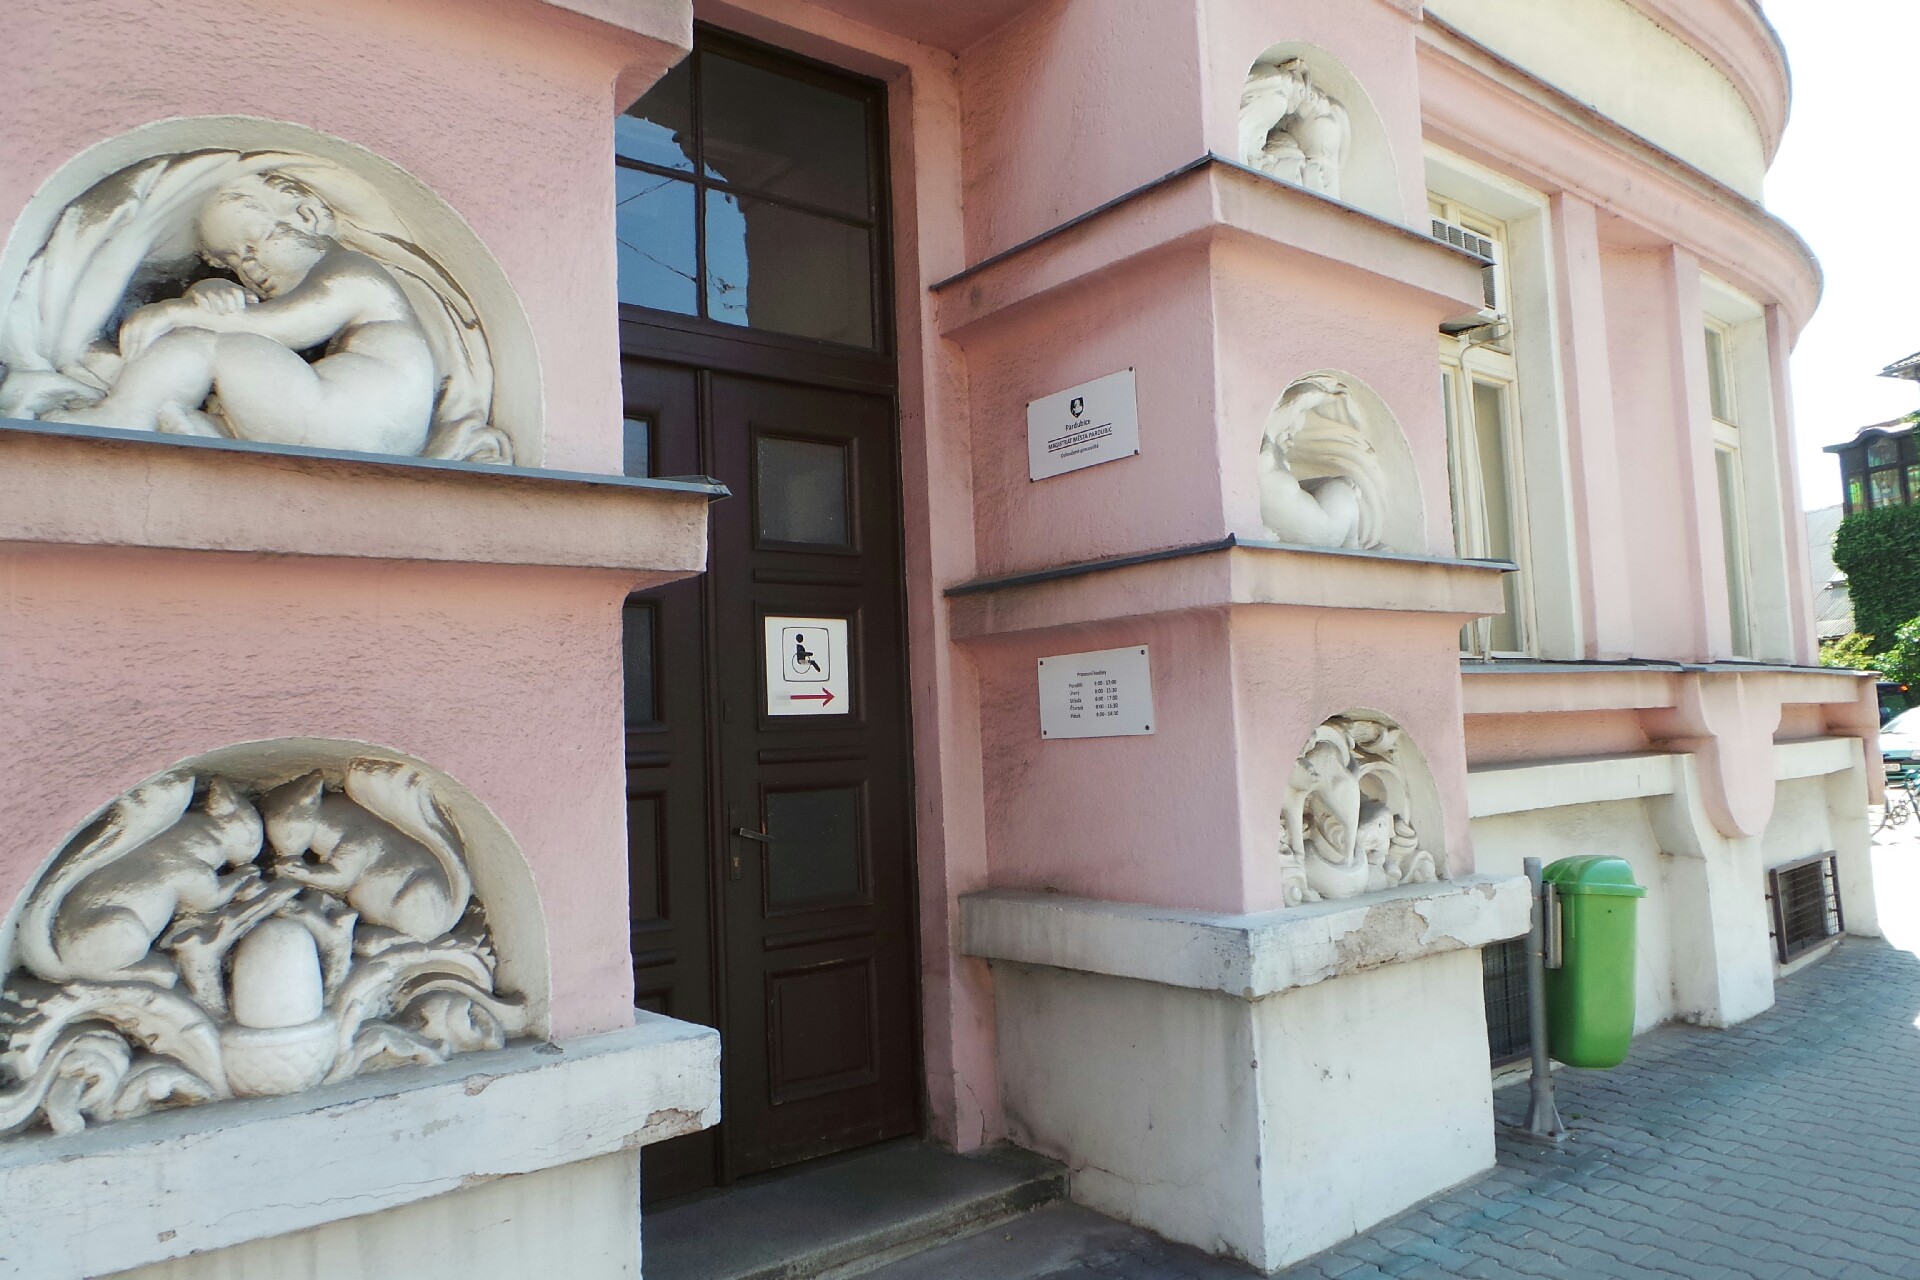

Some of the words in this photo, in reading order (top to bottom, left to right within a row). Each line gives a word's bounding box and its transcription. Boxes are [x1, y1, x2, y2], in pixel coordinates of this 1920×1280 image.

[1065, 419, 1091, 431] Pardubice
[1073, 433, 1088, 443] MĚSTA
[1088, 426, 1112, 438] PARDUBIC
